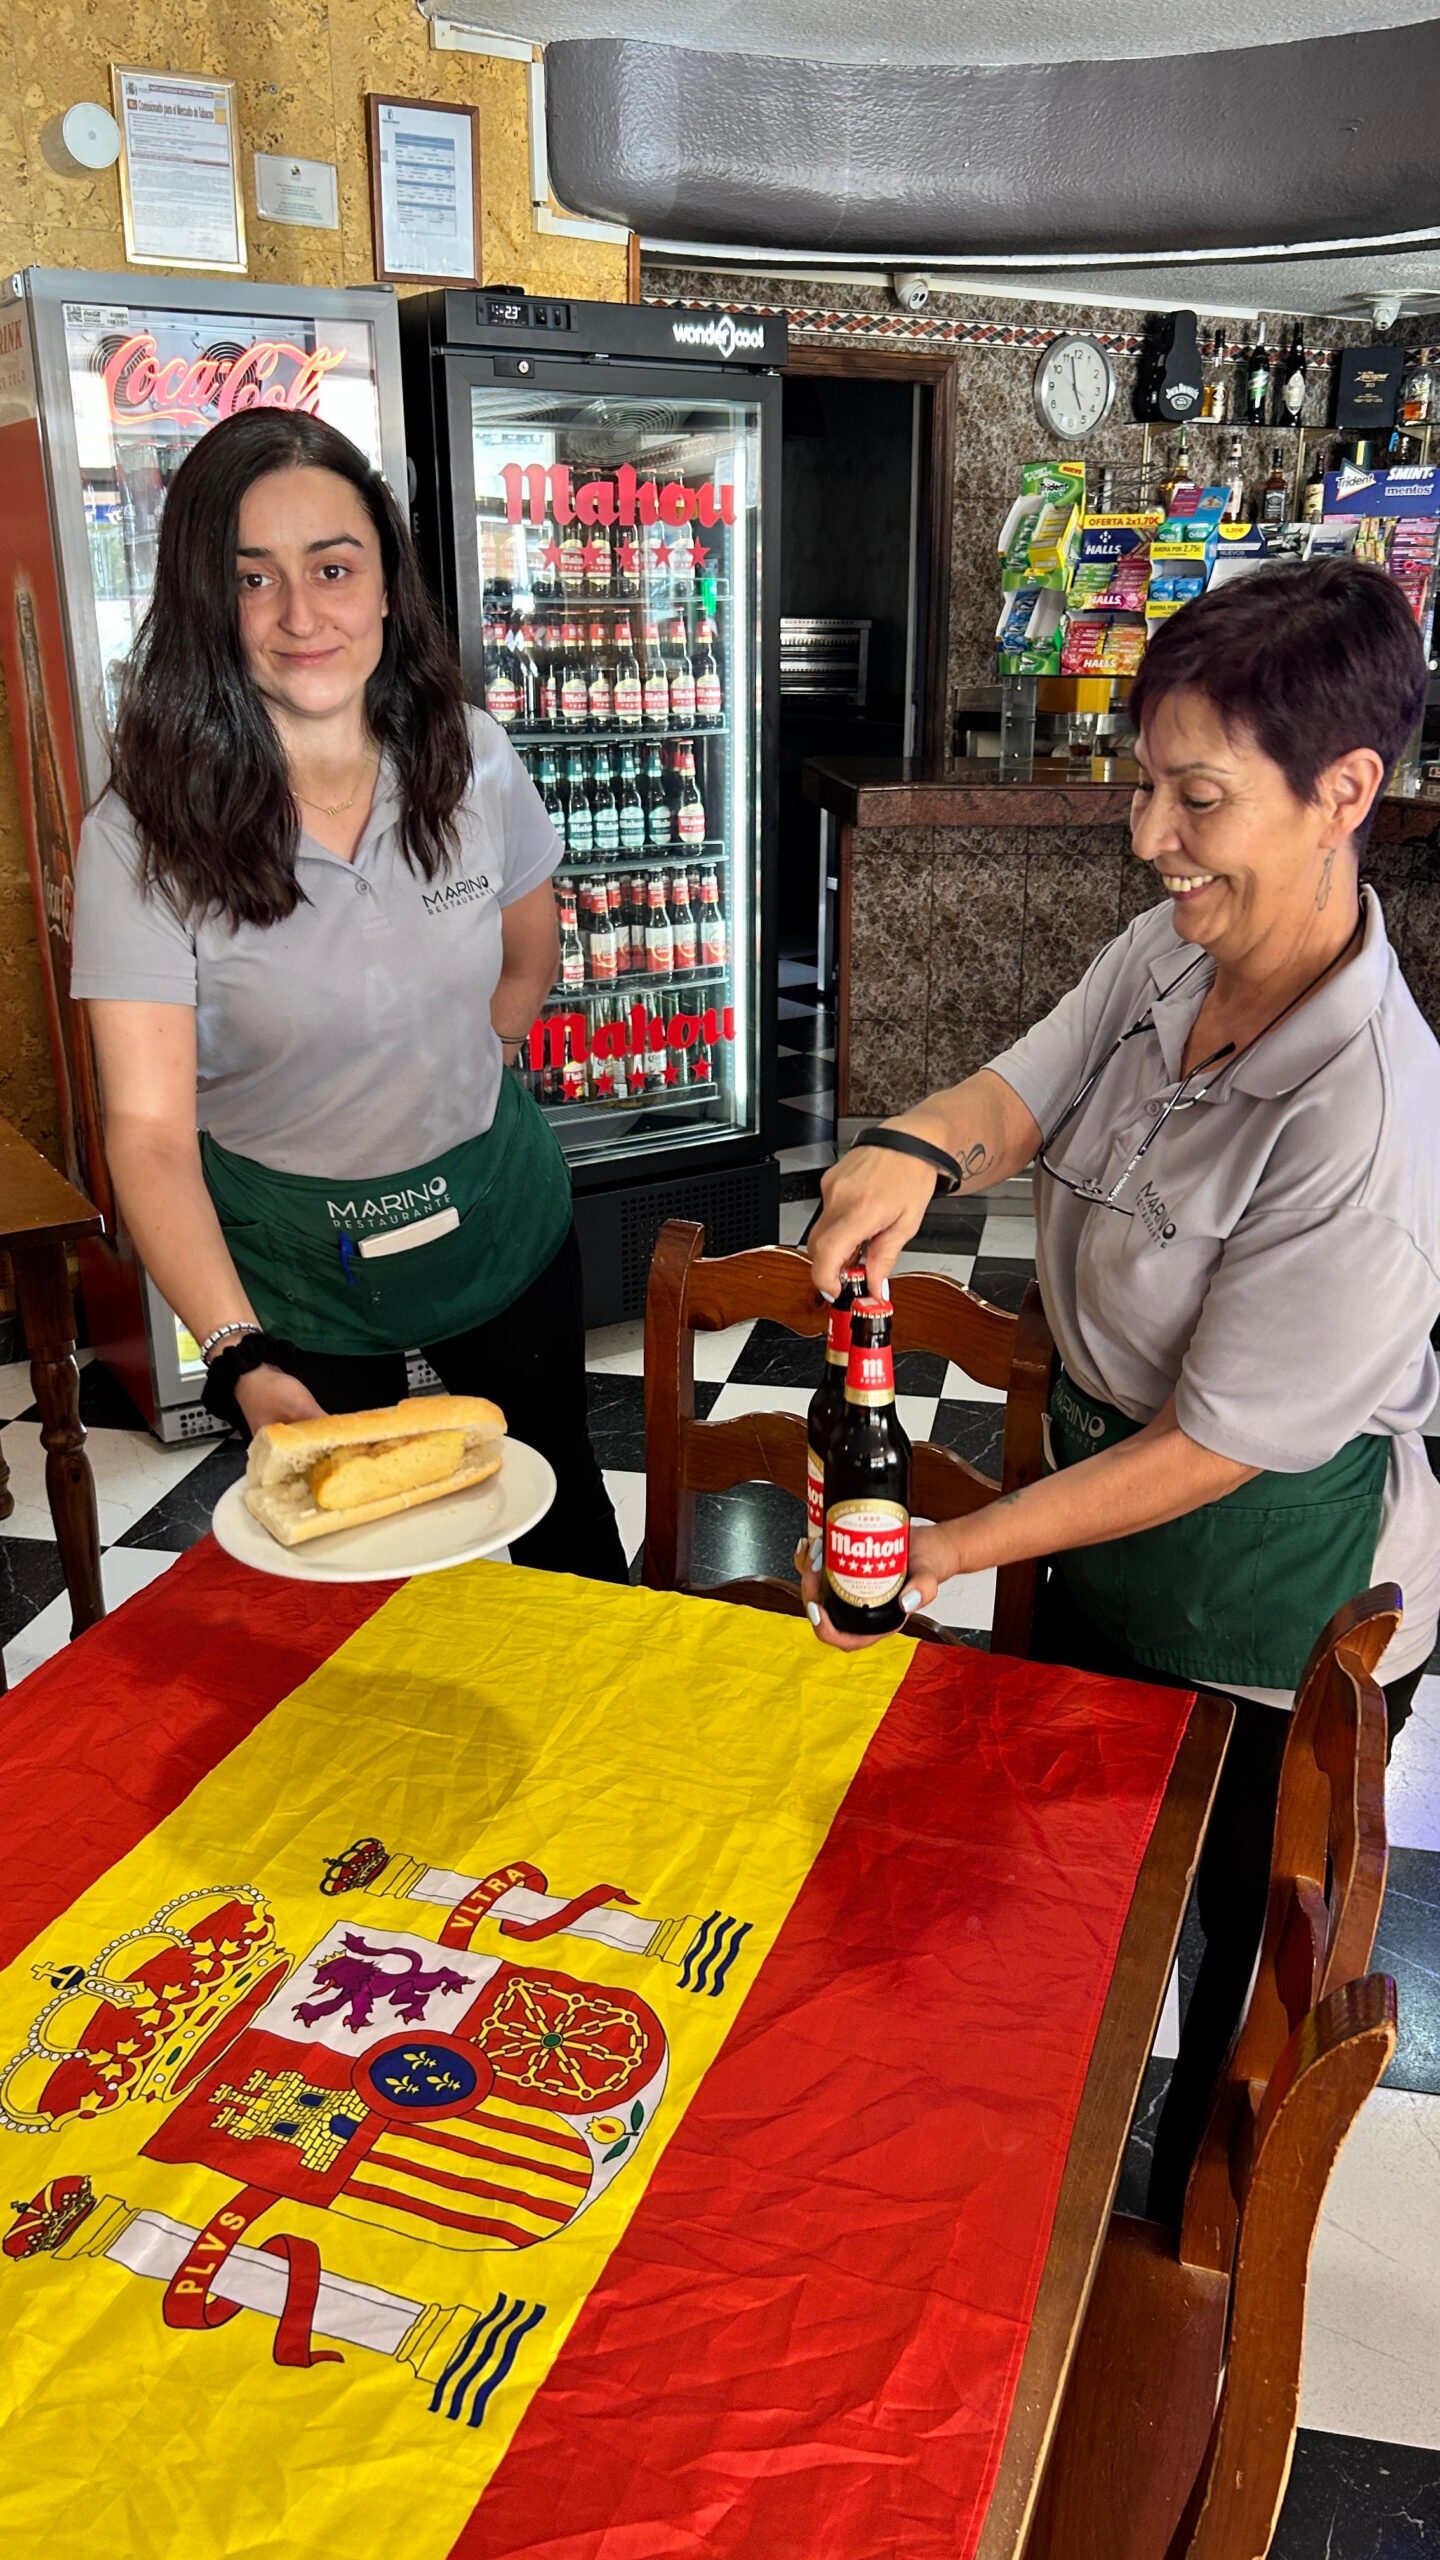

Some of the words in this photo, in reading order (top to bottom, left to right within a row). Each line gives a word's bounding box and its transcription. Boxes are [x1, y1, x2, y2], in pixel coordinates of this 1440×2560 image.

[138, 99, 163, 114] Comisionado
[176, 104, 193, 117] Mercado
[198, 106, 214, 120] Tabacos
[1063, 353, 1070, 362] 11
[1074, 349, 1083, 360] 12
[1054, 364, 1062, 374] 10
[1094, 369, 1100, 379] 2
[1048, 381, 1055, 391] 9
[1096, 386, 1100, 396] 3
[1090, 404, 1096, 412] 4
[1080, 414, 1087, 424] 5
[1387, 467, 1431, 480] SMINT
[1336, 473, 1375, 489] Trident
[1040, 482, 1069, 492] Trident
[1385, 484, 1434, 497] mentos
[499, 462, 738, 528] Mahou
[1088, 518, 1124, 526] OFERTA
[1085, 545, 1122, 554] HALLS
[1090, 595, 1122, 605] HALLS
[1083, 659, 1117, 668] HALLS
[422, 875, 488, 908] MARINO
[526, 1003, 737, 1072] Mahou
[326, 1176, 448, 1219] MARINO
[332, 1193, 452, 1229] RESTAURANTE
[830, 1530, 904, 1559] Mahou
[450, 1868, 526, 1928] VLTRA
[175, 2212, 246, 2294] PLVS
